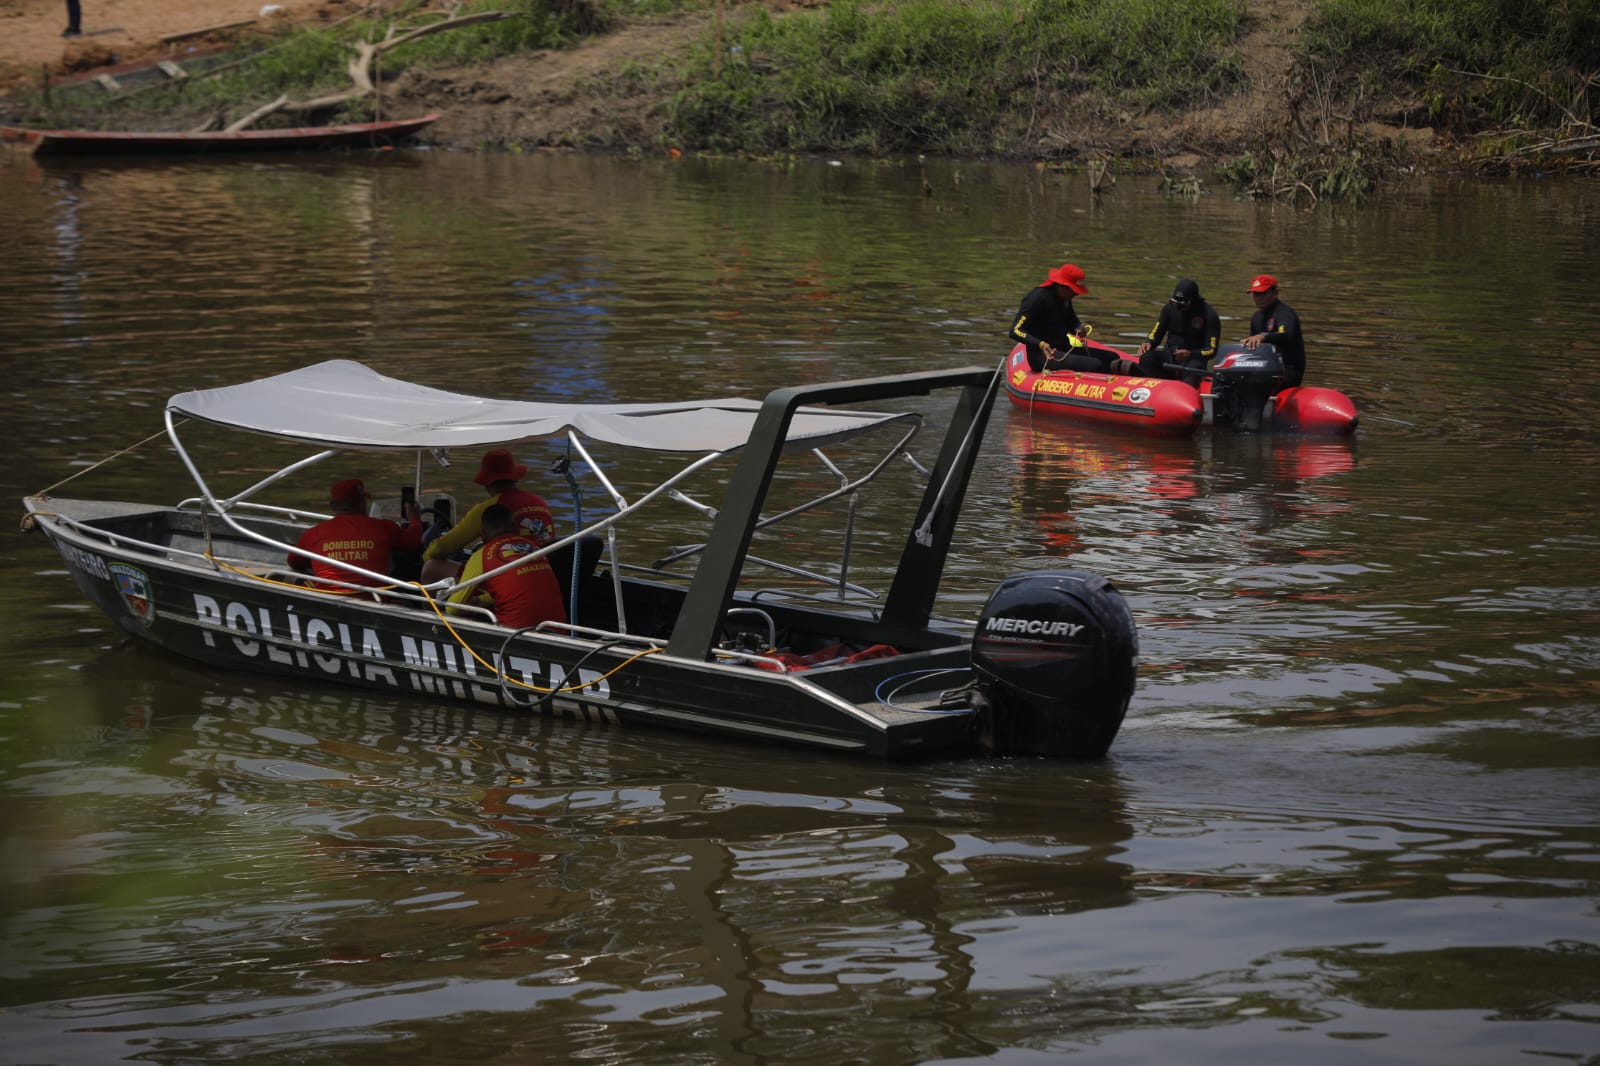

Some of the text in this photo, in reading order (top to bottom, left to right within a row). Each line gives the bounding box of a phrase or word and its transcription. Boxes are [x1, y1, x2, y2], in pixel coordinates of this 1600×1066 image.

[1074, 384, 1106, 399] MILITAR
[322, 540, 374, 552] BOMBEIRO
[327, 551, 369, 561] MILITAR
[985, 617, 1085, 637] MERCURY
[193, 593, 621, 724] POLÍCIA MILITAR
